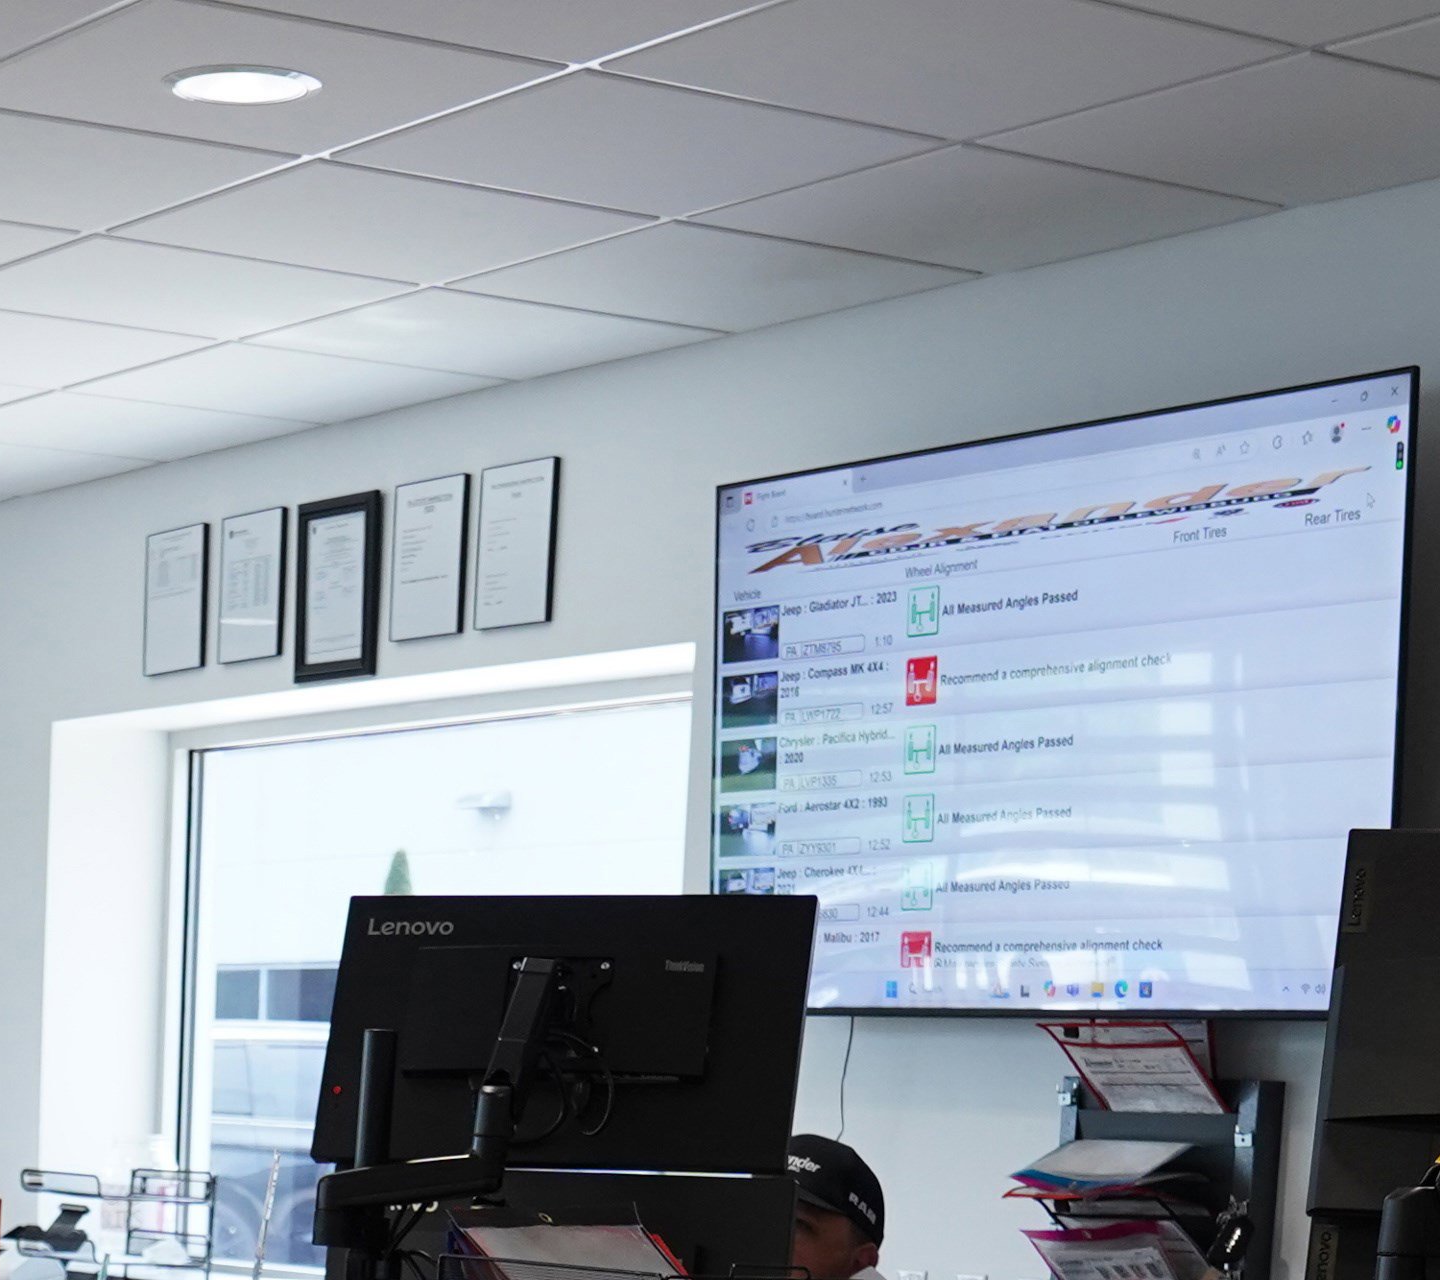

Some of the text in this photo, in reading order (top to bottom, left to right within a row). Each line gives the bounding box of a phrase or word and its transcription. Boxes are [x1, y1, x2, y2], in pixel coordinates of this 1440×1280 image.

[1121, 490, 1292, 518] LEWISBURG
[748, 466, 1372, 575] Alexander
[1305, 507, 1360, 525] Rear Tires
[1173, 526, 1227, 544] Front Tires
[905, 560, 978, 578] Wheel Alignment
[734, 589, 761, 602] Vehicle
[782, 604, 802, 617] Jeep
[809, 599, 849, 614] Gladiator
[876, 591, 898, 603] 2023
[942, 590, 1079, 617] All Measured Angles Passed
[780, 661, 884, 683] Jeep Compass MK 4X4
[941, 671, 999, 687] Recommend
[1010, 662, 1085, 681] comprehensive
[1087, 656, 1138, 674] alignment
[1141, 652, 1171, 667] check
[871, 703, 893, 716] 12:57
[779, 735, 815, 749] Chrysler
[823, 731, 856, 745] Pacifica
[938, 735, 1074, 756] All Measured Angles Passed
[784, 752, 804, 764] 2020
[869, 771, 892, 784] 12:53
[778, 801, 798, 814] Ford
[804, 799, 840, 812] Aerostar
[937, 806, 1071, 825] All Measured Angles Passed
[868, 839, 891, 851] 12:52
[777, 865, 845, 881] Jeep Cherokee
[935, 878, 1071, 894] All Measured Angles Passed
[1348, 868, 1367, 926] Lenovo
[867, 906, 889, 918] 12:44
[367, 918, 454, 936] Lenovo
[824, 931, 880, 943] Malibu 2017
[934, 941, 993, 953] Recommend
[1003, 940, 1077, 953] comprehensive
[1080, 939, 1130, 953] alignment
[1132, 939, 1163, 951] check
